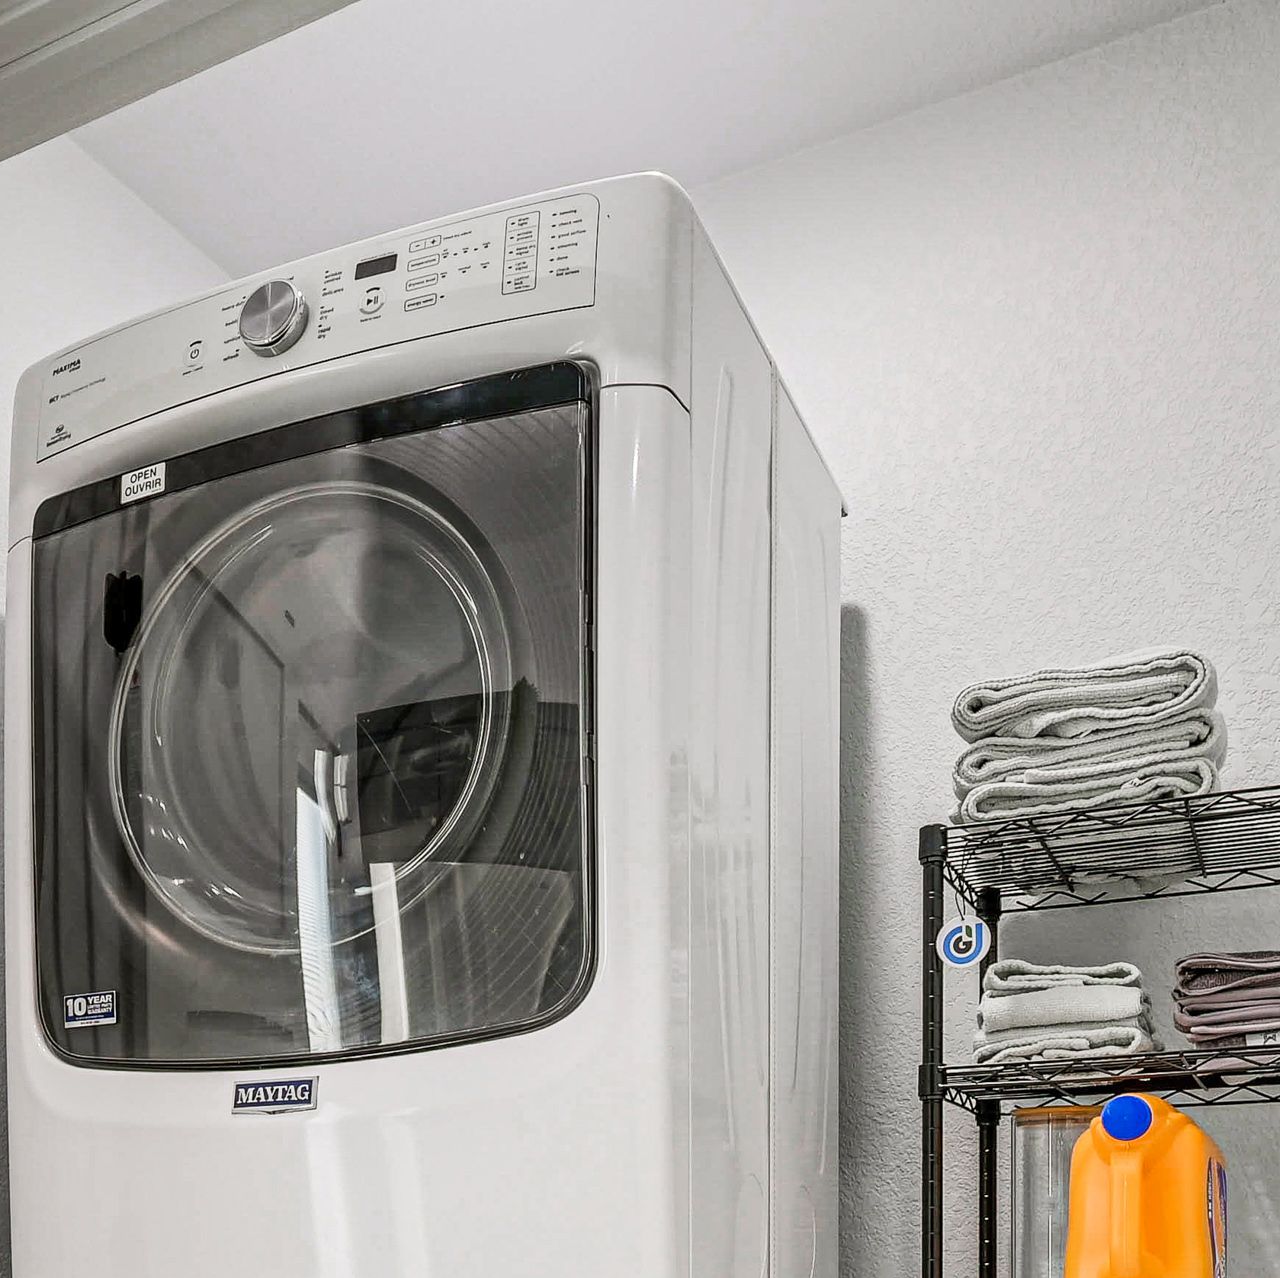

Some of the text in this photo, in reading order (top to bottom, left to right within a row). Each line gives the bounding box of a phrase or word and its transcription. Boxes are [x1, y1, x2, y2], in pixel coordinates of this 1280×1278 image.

[130, 467, 157, 484] OPEN
[124, 478, 162, 497] OUVRIR
[66, 994, 113, 1017] 10 YEAR
[236, 1083, 311, 1105] MAYTAG
